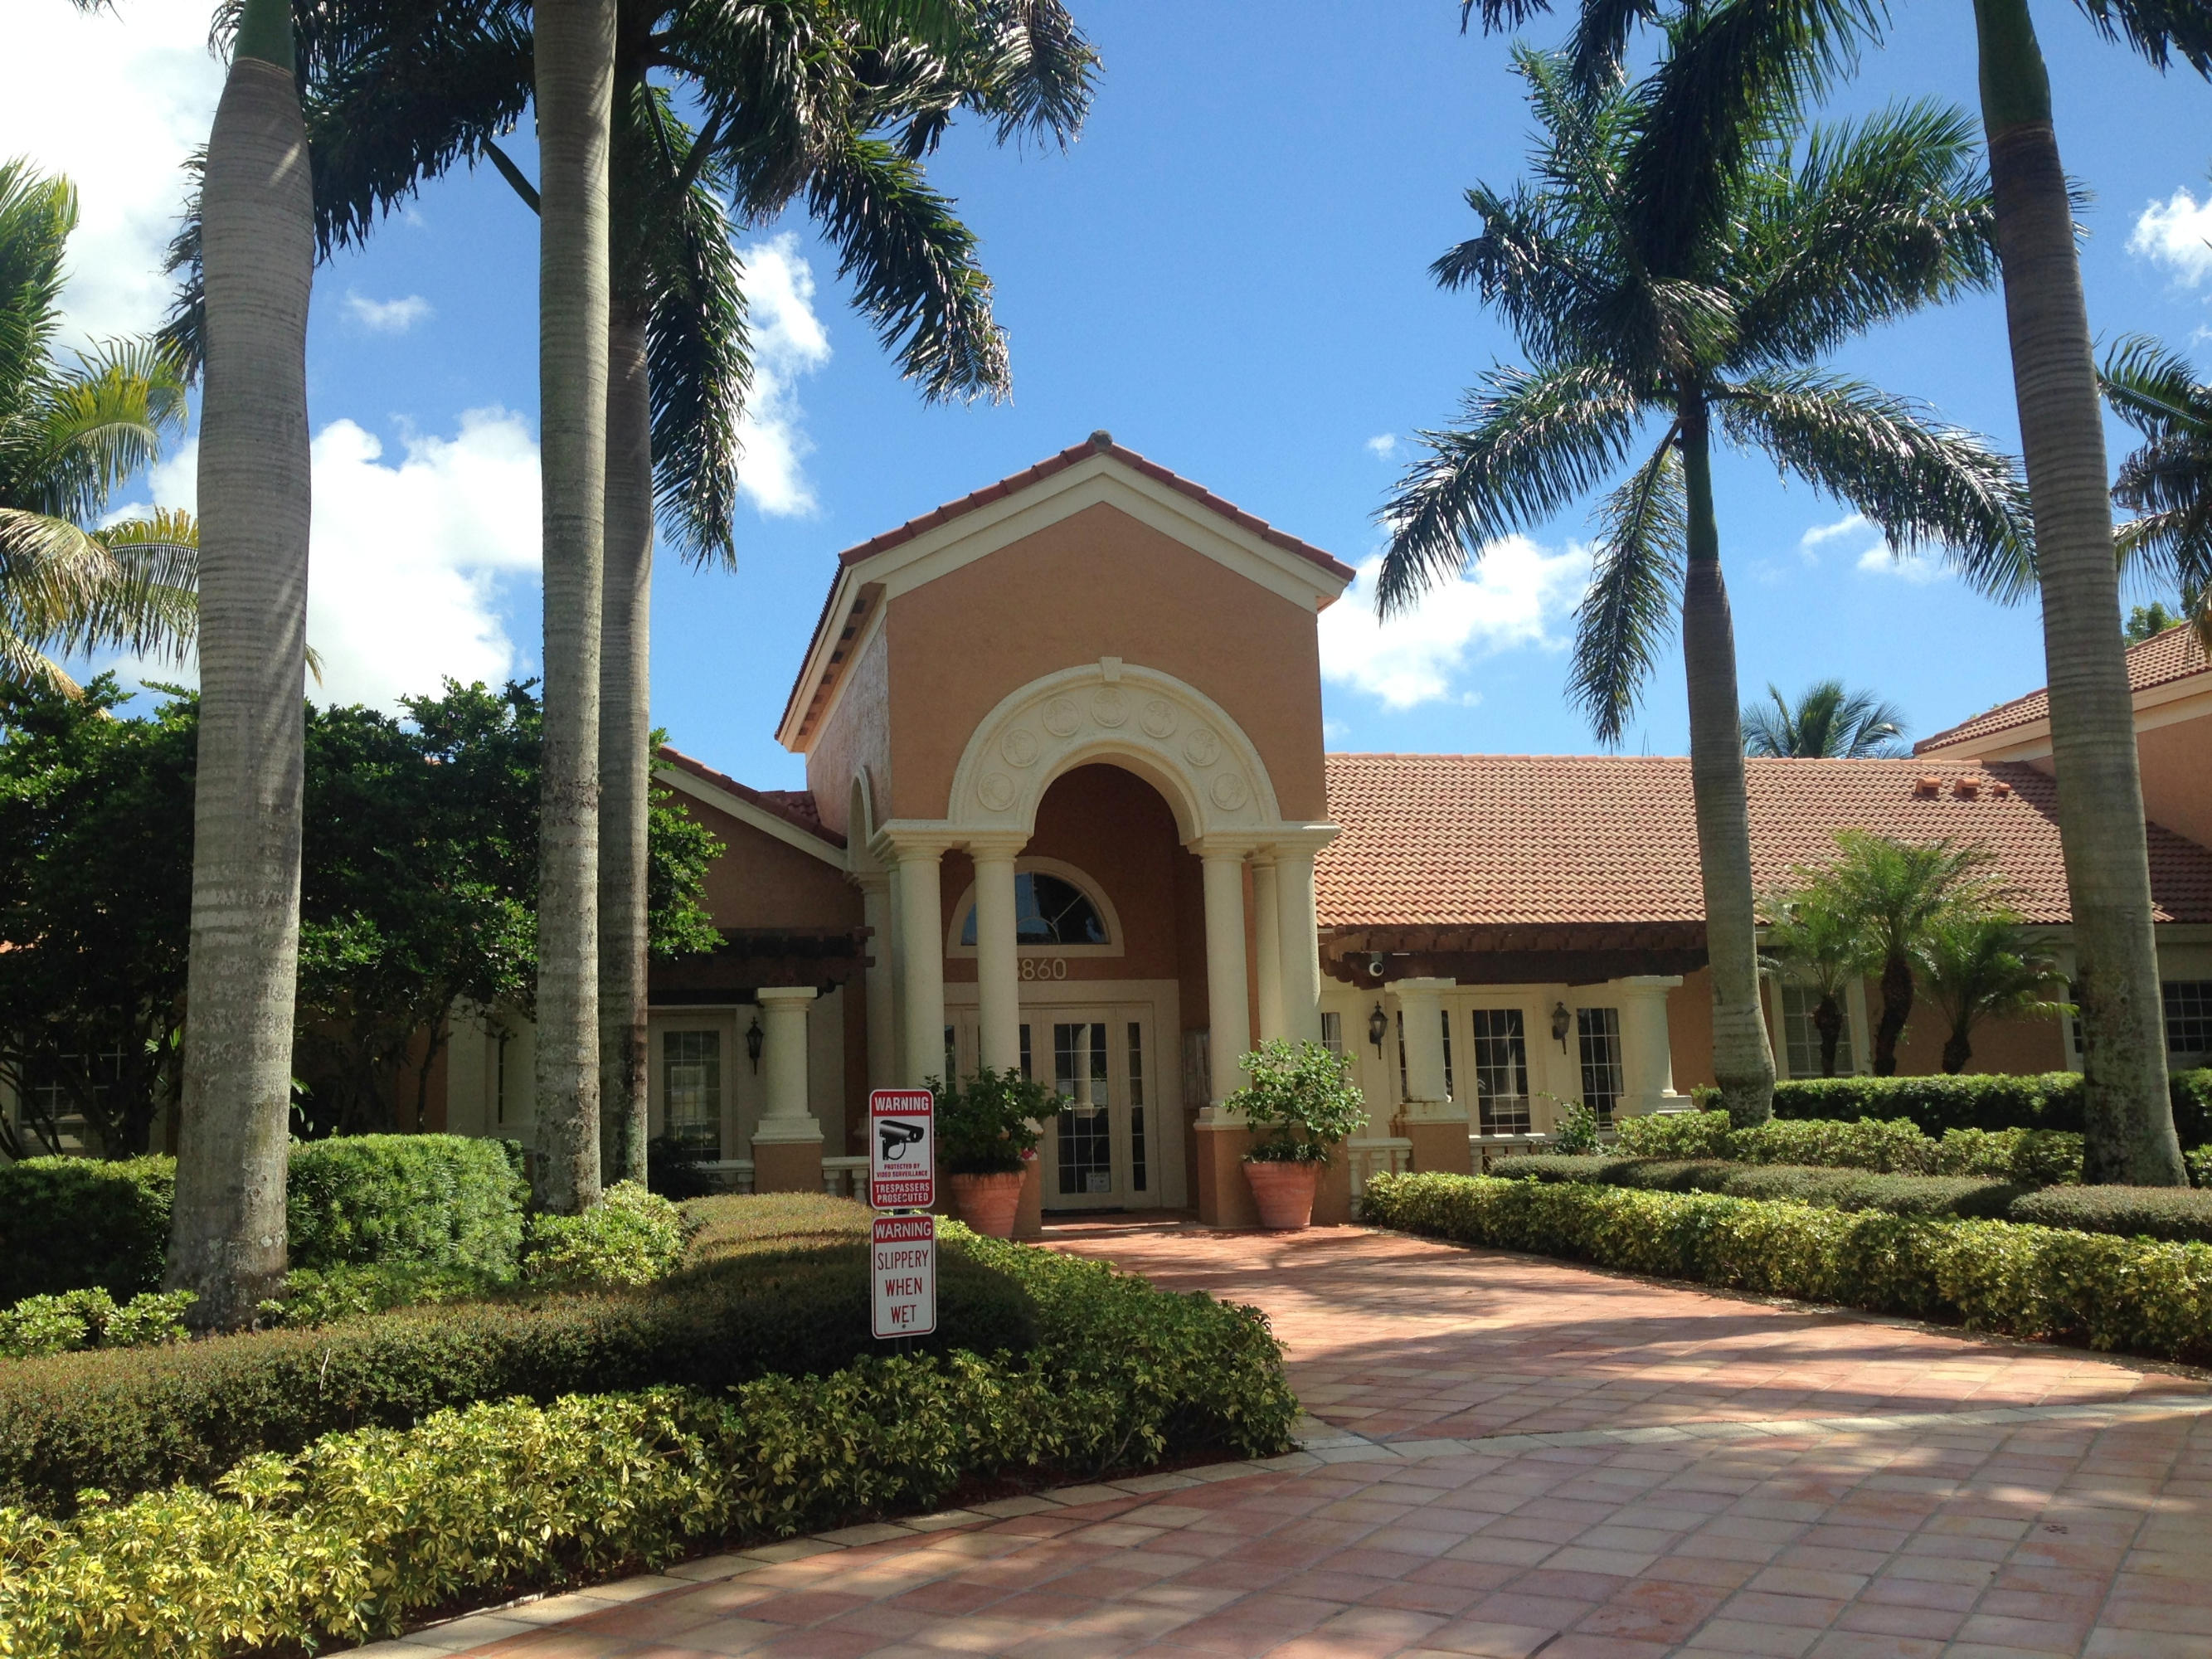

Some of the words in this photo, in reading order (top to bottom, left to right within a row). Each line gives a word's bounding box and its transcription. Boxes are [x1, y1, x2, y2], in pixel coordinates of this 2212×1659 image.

[1017, 958, 1067, 980] 860
[874, 1096, 929, 1112] WARNING
[875, 1182, 930, 1194] TRESPASSERS
[877, 1192, 929, 1204] PROSECUTED
[875, 1221, 931, 1239] WARNING
[878, 1249, 929, 1271] SLIPPERY
[885, 1277, 922, 1297] WHEN
[891, 1305, 916, 1324] WET
